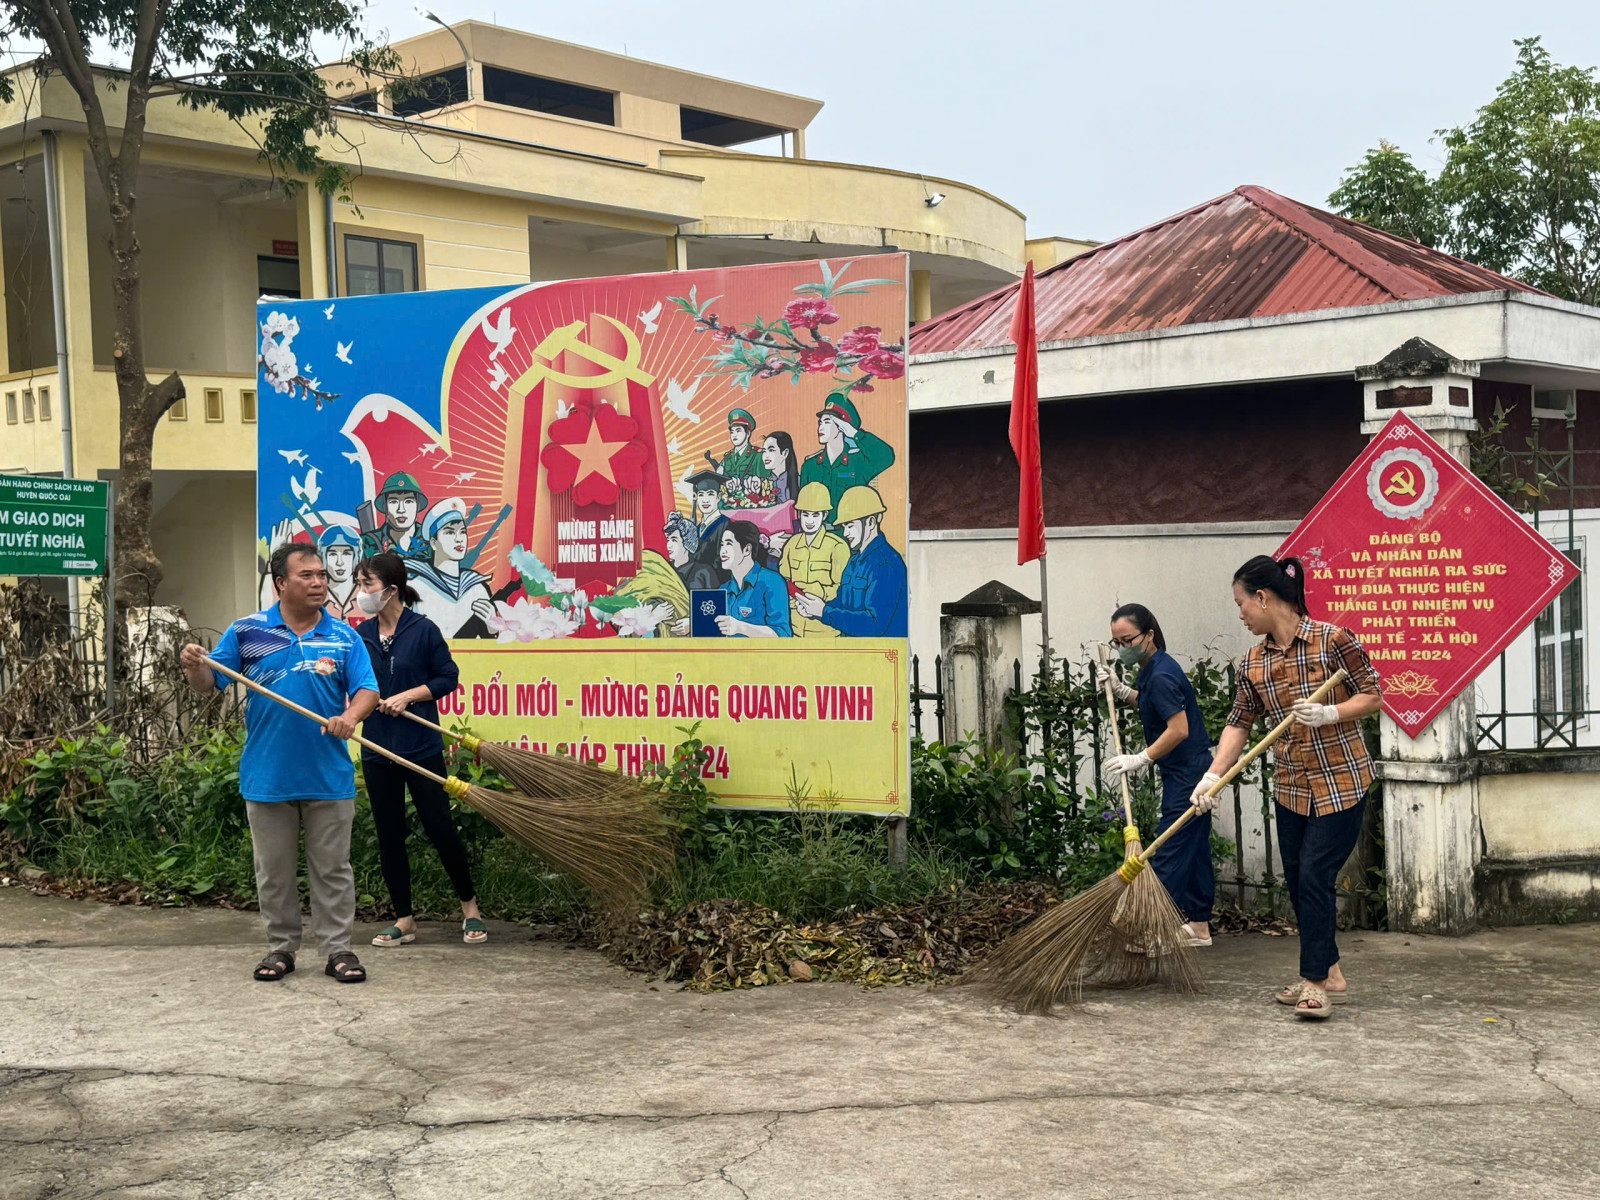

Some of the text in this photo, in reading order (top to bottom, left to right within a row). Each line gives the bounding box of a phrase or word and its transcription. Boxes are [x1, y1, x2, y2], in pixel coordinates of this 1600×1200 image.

[12, 479, 32, 489] HÀNG
[33, 481, 54, 491] CHÍNH
[54, 481, 72, 491] SÁCH
[59, 493, 71, 501] OAI
[12, 511, 50, 526] GIAO
[52, 513, 85, 529] DỊCH
[558, 514, 635, 540] MỪNG ĐẢNG
[1369, 530, 1441, 545] ĐẢNG BỘ
[558, 540, 635, 563] MỪNG XUÂN
[1351, 547, 1462, 562] VÀ NHÂN DÂN
[1312, 562, 1507, 580] XÃ TUYẾT NGHĨA RA SỨC
[1333, 580, 1485, 596] THI ĐUA THỰC HIỆN
[1325, 597, 1495, 613] THẮNG LỢI NHIỆM VỤ
[1362, 612, 1456, 628] PHÁT TRIỂN
[1355, 633, 1382, 644] INH
[1386, 630, 1406, 644] TẾ
[1422, 631, 1445, 644] XÃ
[1449, 631, 1478, 646] HỘI
[1369, 648, 1452, 661] NĂM 2024
[472, 670, 508, 716] ĐỔI
[516, 676, 558, 717] MỚI
[581, 676, 649, 718] MỪNG
[655, 672, 720, 719] ĐẢNG
[728, 684, 807, 723] QUANG
[815, 685, 873, 721] VINH
[673, 745, 730, 780] 24
